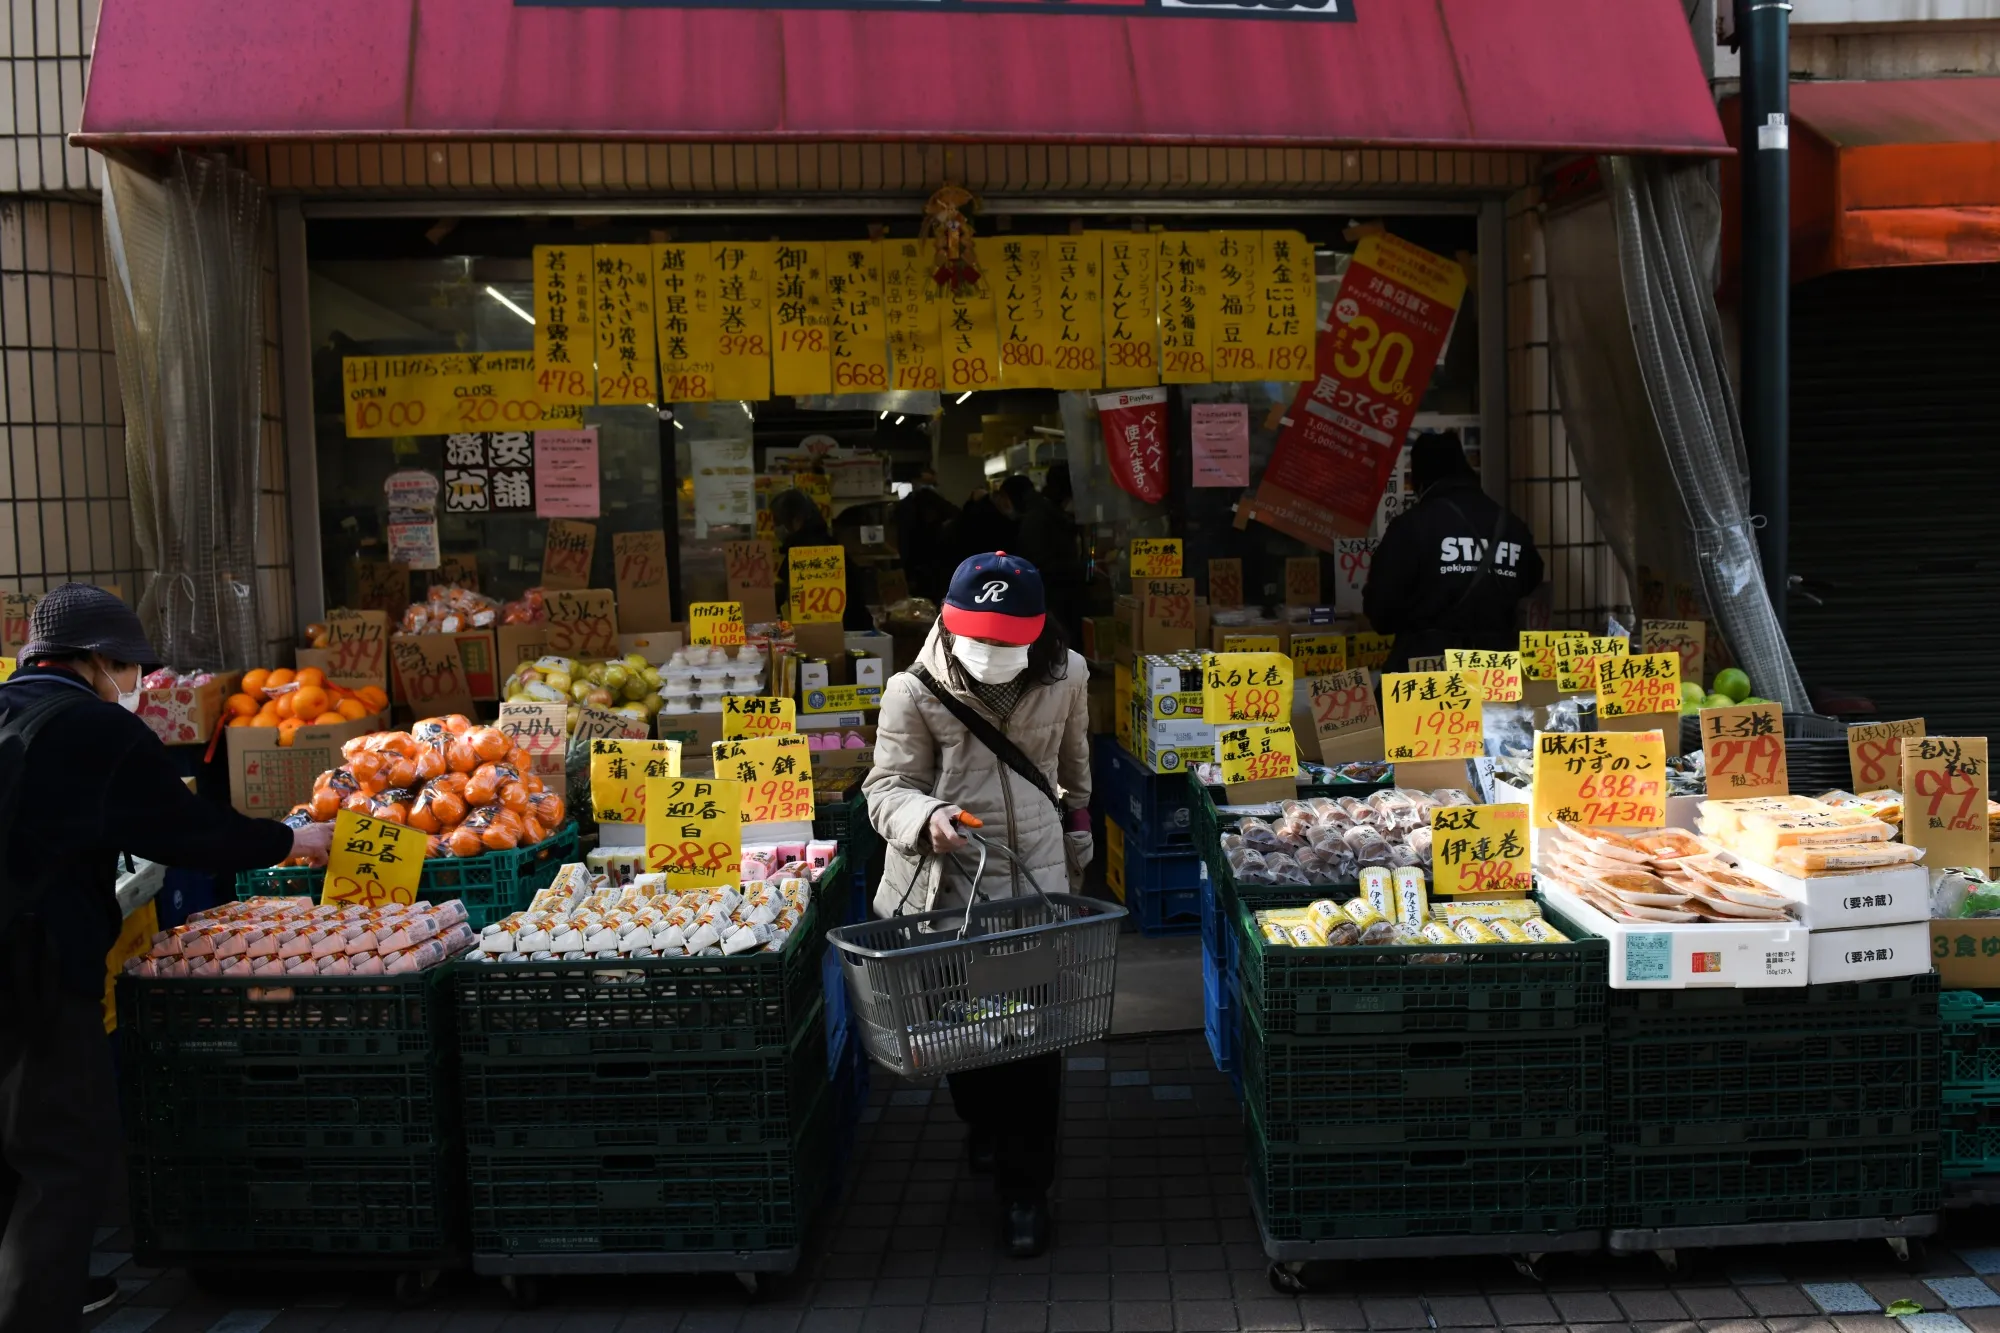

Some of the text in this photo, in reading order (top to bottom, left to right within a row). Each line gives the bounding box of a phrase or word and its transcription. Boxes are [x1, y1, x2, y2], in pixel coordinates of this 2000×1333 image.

[1272, 239, 1293, 284] 黄金
[715, 246, 749, 334] 伊達巻
[774, 246, 808, 326] 御蒲鉾
[848, 251, 870, 336] 栗いっぱい
[1003, 242, 1028, 343] 栗きんとん
[1058, 241, 1080, 342] 豆きんとん
[1112, 240, 1133, 340] 豆きんとん
[1219, 236, 1243, 343] お多福豆
[1367, 276, 1432, 317] 対象店舗で
[546, 250, 571, 364] 若あゆ甘露煮
[596, 258, 615, 350] 焼きあさり
[661, 248, 688, 360] 越中昆布巻
[1266, 287, 1281, 336] にしん
[1283, 287, 1299, 336] こはだ
[829, 275, 852, 358] 栗きんとん
[351, 386, 387, 401] OPEN
[453, 384, 496, 398] CLOSE
[1129, 394, 1154, 403] PayPay
[1312, 373, 1401, 429] 戻ってくる
[446, 432, 531, 467] 激安
[1141, 411, 1161, 472] ペイペイ
[1124, 424, 1149, 493] 使えます。
[447, 470, 531, 510] 本舗
[1440, 536, 1522, 567] STAFF
[974, 580, 1009, 604] R
[694, 605, 742, 617] かがみも
[1557, 639, 1624, 657] 日高昆布
[1452, 651, 1518, 670] 早煮昆布
[1600, 656, 1675, 684] 昆布巻き
[1207, 665, 1283, 689] なると巻
[1310, 667, 1367, 698] 松前漬
[1391, 673, 1467, 703] 伊達巻
[1470, 669, 1518, 687] 18円
[1620, 678, 1675, 698] 248円
[726, 699, 782, 713] 大納言
[1224, 689, 1280, 718] ¥88
[1439, 699, 1471, 710] ハーフ
[1483, 687, 1522, 702] 35円)
[501, 717, 561, 737] みかん
[621, 727, 647, 740] Dole
[744, 714, 792, 731] 200円
[1415, 711, 1480, 735] 198円
[1851, 721, 1920, 743] 山芋入りそば
[1237, 736, 1273, 759] 黒豆
[1541, 734, 1608, 755] 味付き
[608, 758, 670, 780] 蒲鉾
[737, 755, 796, 783] 蒲鉾
[1245, 751, 1291, 771] 299円
[1564, 752, 1652, 775] かずのこ
[1945, 756, 1987, 777] そば
[620, 785, 646, 804] 19
[667, 782, 712, 798] 夕月
[747, 780, 810, 804] 198円
[1578, 774, 1659, 799] 688円
[665, 800, 726, 819] 迎春
[1433, 808, 1480, 831] 紀文
[354, 817, 402, 842] 夕月
[681, 822, 702, 838] 白
[344, 837, 403, 863] 迎春
[648, 841, 741, 872] 288円
[1440, 829, 1525, 865] 伊達巻
[356, 863, 379, 880] 赤
[1370, 890, 1382, 912] 伊達
[1842, 892, 1895, 910] (要冷蔵)
[1844, 946, 1895, 964] (要冷蔵)
[1933, 933, 2000, 958] 3食ゆ
